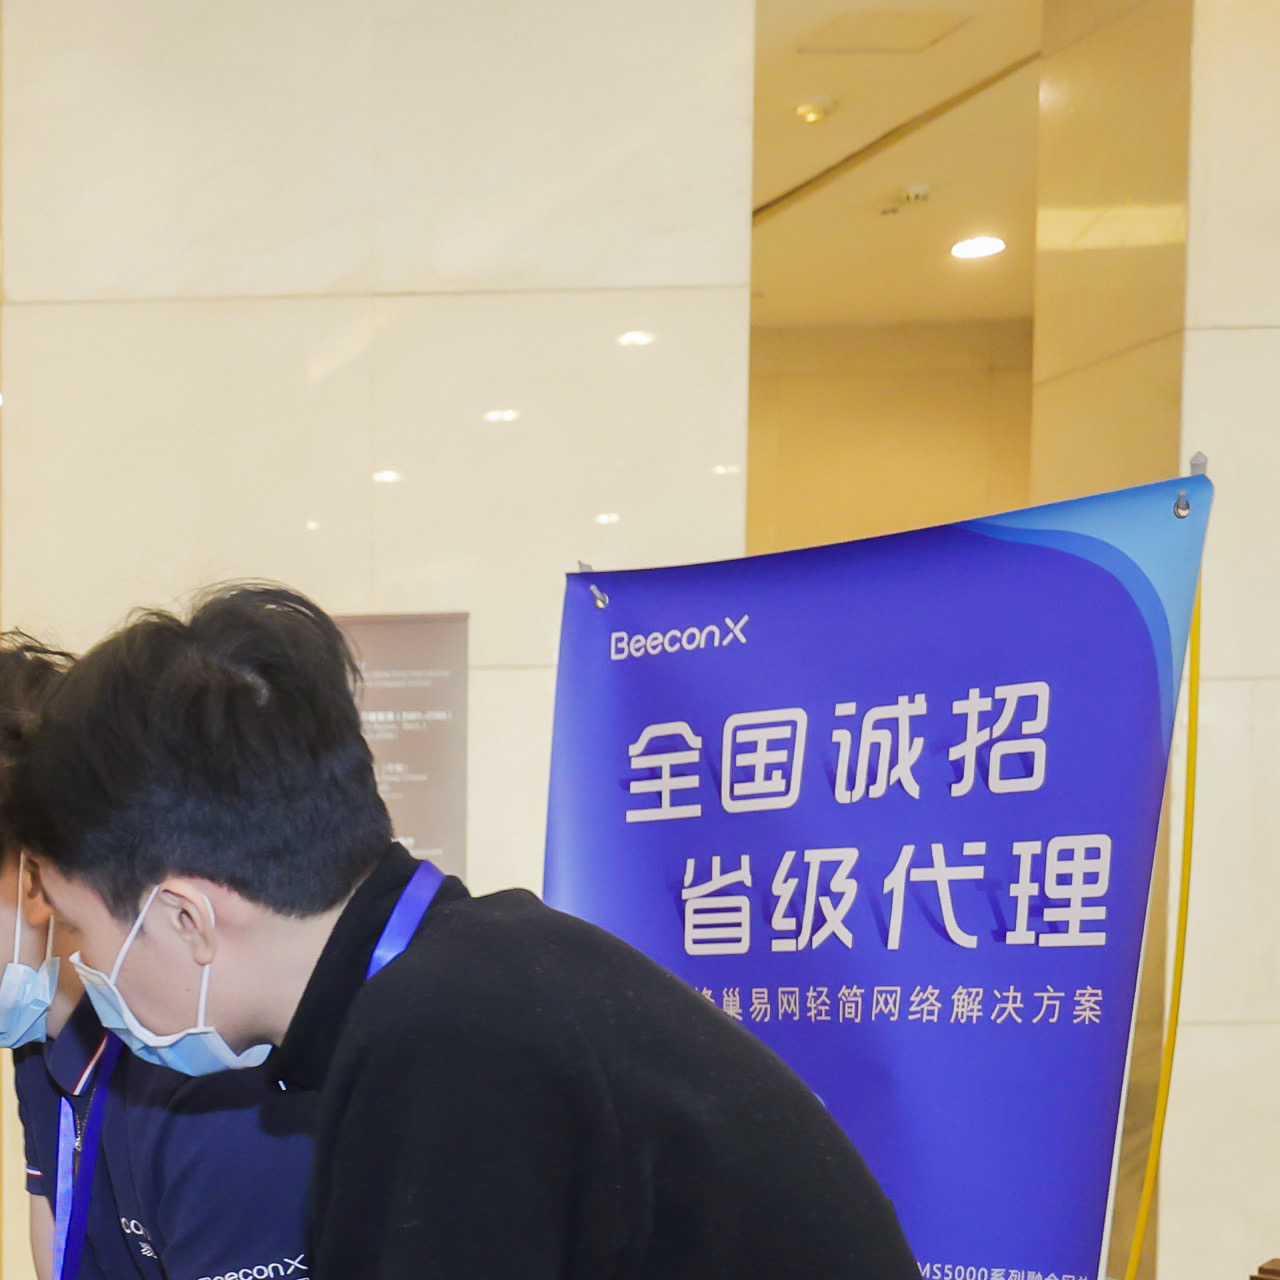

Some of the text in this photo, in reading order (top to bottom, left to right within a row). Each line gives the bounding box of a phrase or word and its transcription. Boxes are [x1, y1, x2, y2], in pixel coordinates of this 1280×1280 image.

[609, 613, 750, 662] BeeconX
[625, 680, 1051, 824] 全国诚招
[680, 833, 1113, 957] 省级代理
